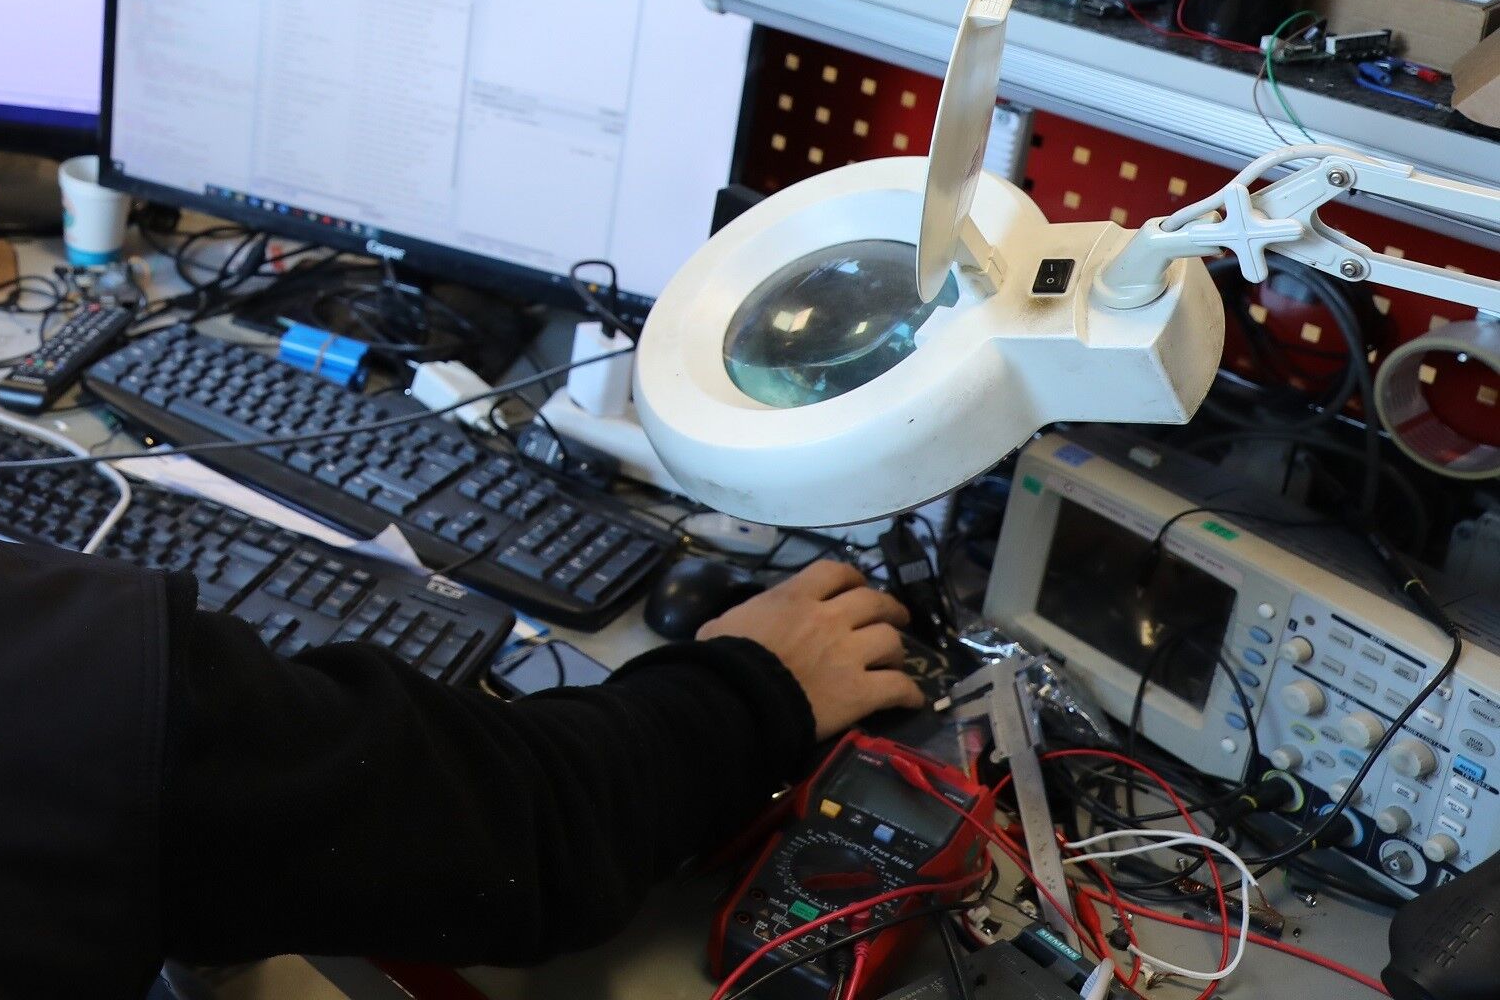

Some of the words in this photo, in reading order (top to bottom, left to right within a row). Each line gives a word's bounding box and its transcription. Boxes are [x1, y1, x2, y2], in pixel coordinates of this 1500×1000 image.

[869, 844, 891, 858] True
[891, 854, 915, 870] RMS
[1036, 927, 1082, 961] SIEMENS
